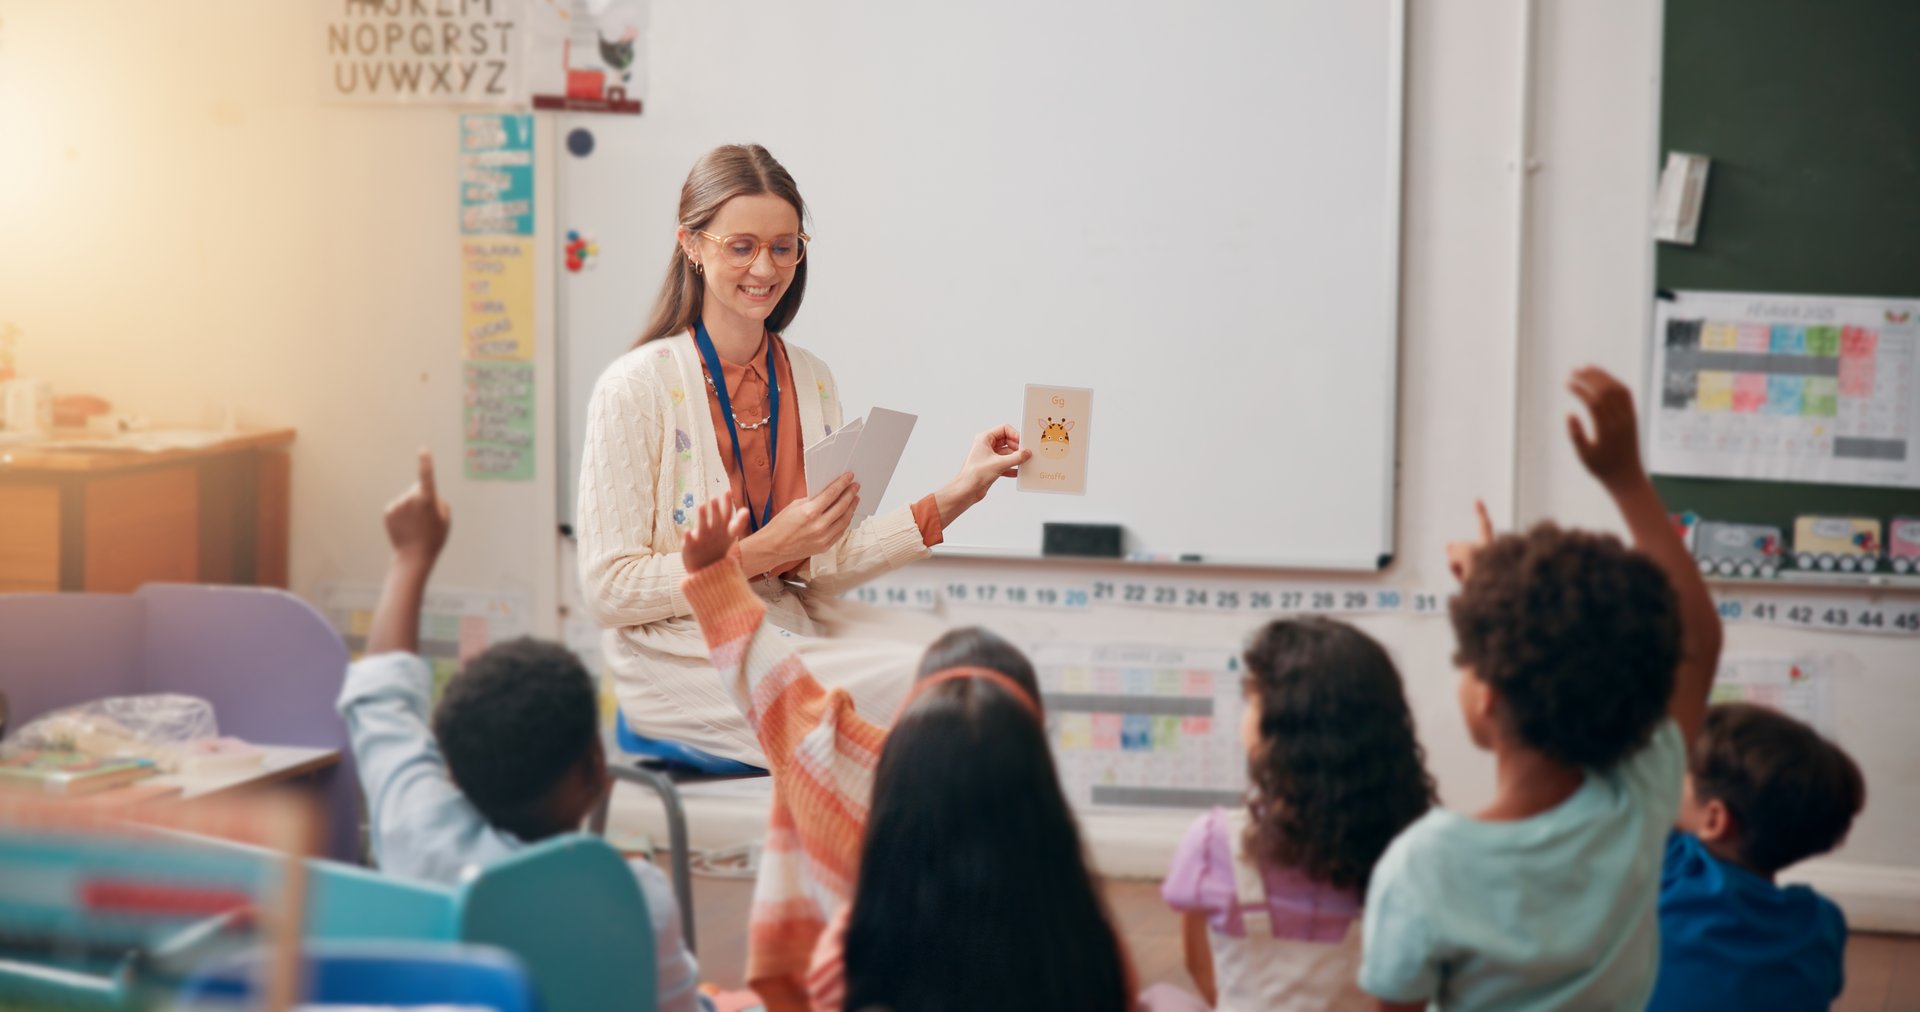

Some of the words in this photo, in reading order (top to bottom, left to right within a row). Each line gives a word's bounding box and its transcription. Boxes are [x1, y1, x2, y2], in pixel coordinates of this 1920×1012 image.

[328, 22, 514, 56] NOPQRST
[335, 61, 507, 94] UVWXYZ
[1051, 395, 1065, 408] Gg
[1039, 471, 1066, 481] Giraffe
[886, 588, 907, 604] 14
[946, 584, 967, 600] 16
[976, 585, 998, 601] 17
[1006, 586, 1027, 602] 18
[1036, 588, 1057, 604] 19
[1064, 589, 1088, 607] 20
[1093, 582, 1115, 599] 21
[1124, 584, 1147, 602] 22
[1153, 586, 1177, 604] 23
[1184, 588, 1208, 606] 24
[1216, 591, 1240, 609] 25
[1249, 591, 1272, 609] 26
[1280, 591, 1303, 609] 27
[1311, 591, 1335, 609] 28
[1343, 591, 1367, 609] 29
[1375, 590, 1399, 608] 30
[1414, 593, 1437, 611] 31
[1718, 601, 1742, 619] 40
[1752, 604, 1777, 621] 41
[1787, 606, 1814, 623] 42
[1822, 608, 1848, 626] 43
[1857, 611, 1884, 628] 44
[1893, 613, 1920, 631] 45
